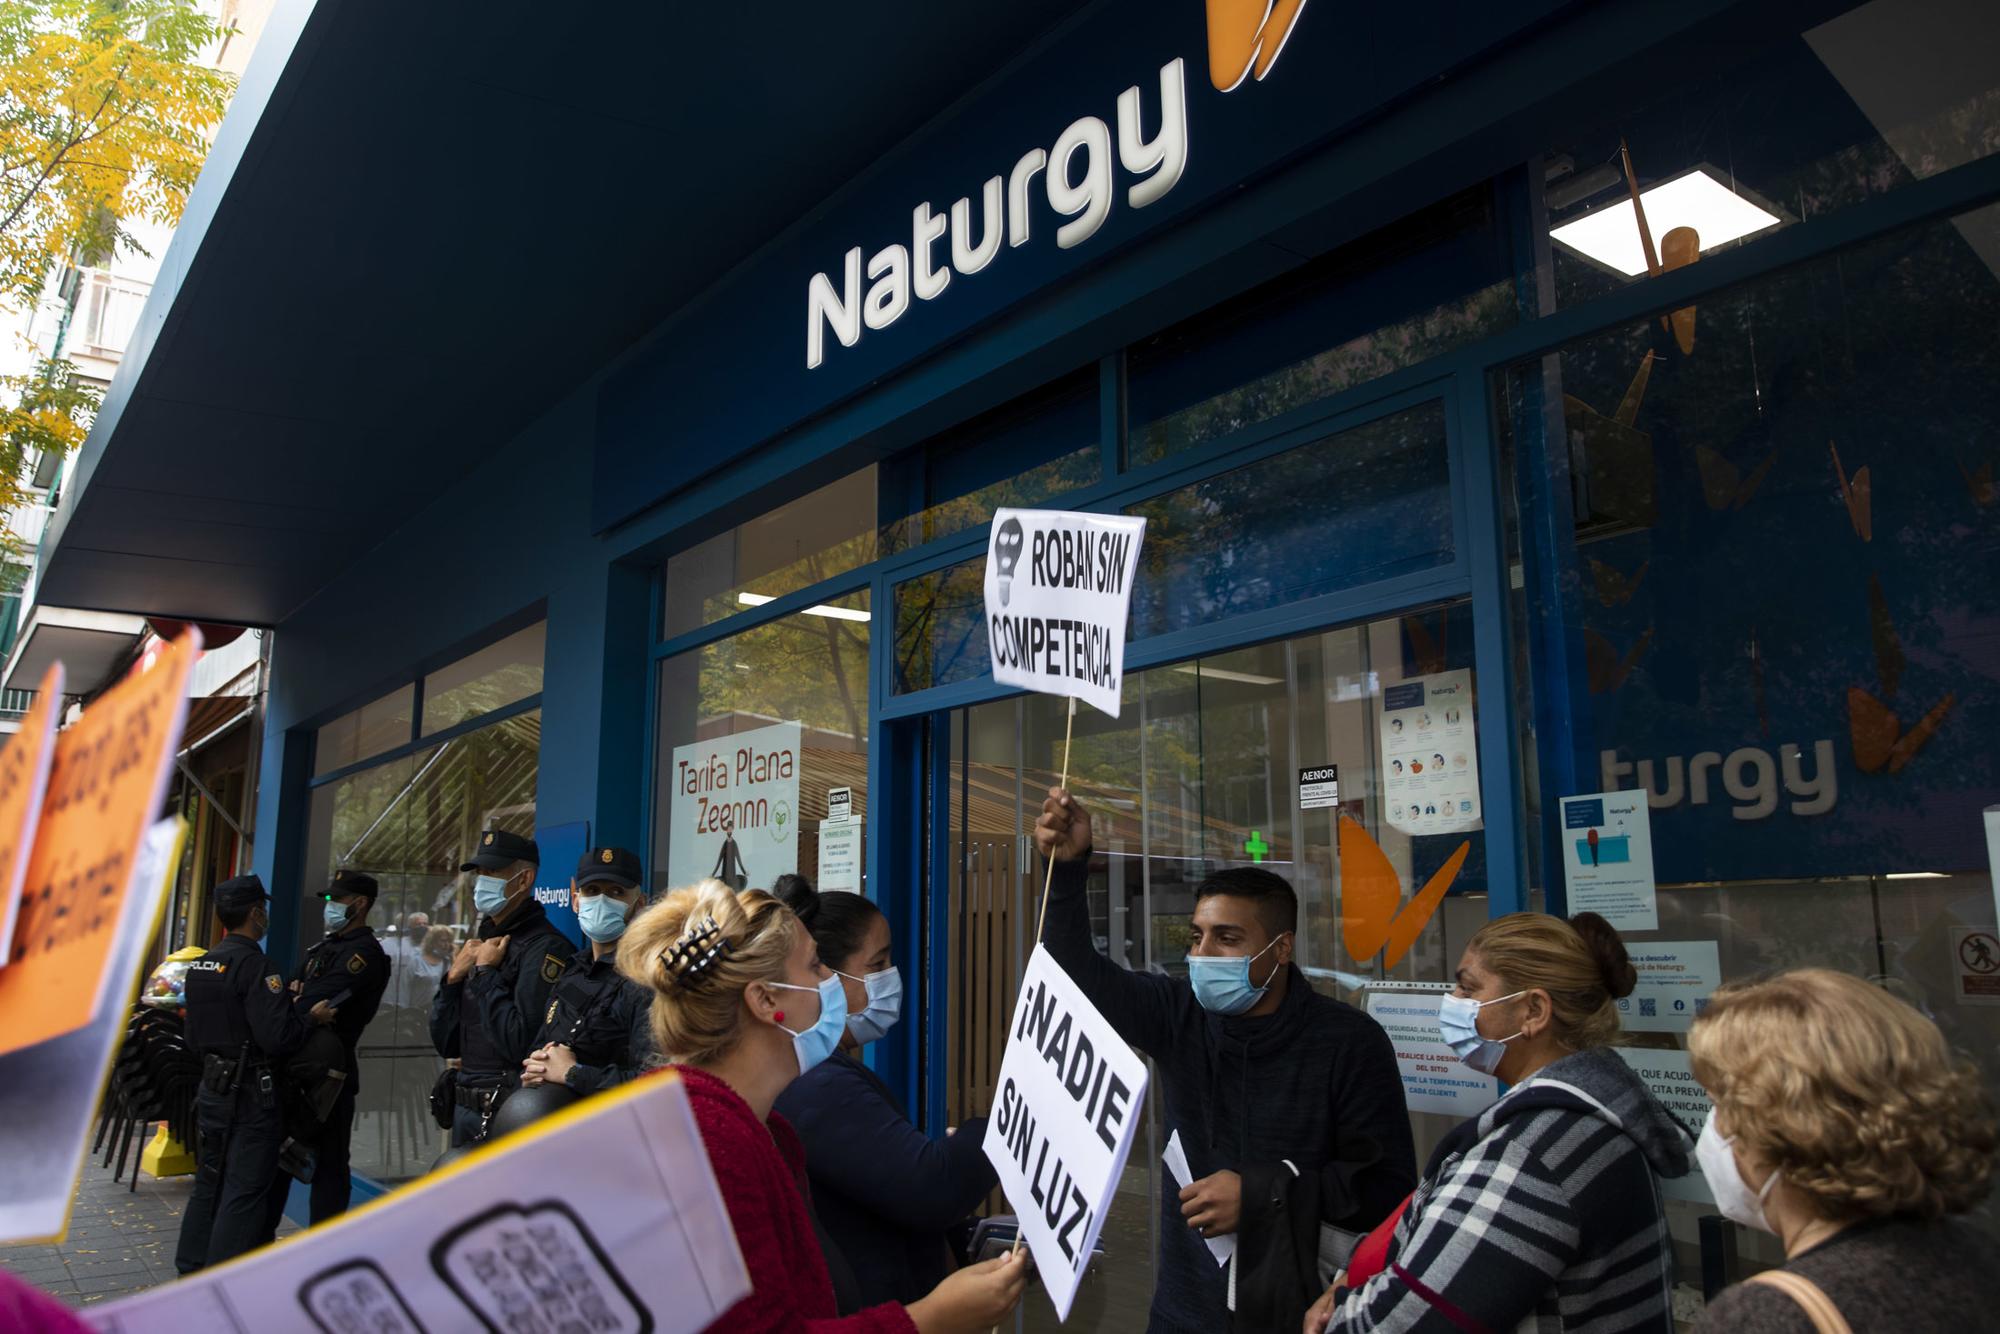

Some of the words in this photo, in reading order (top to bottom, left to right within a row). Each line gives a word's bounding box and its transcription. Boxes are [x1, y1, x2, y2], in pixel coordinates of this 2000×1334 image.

[807, 57, 1188, 370] Naturgy
[1031, 529, 1094, 591] ROBAN
[1097, 531, 1131, 594] SIN
[992, 614, 1116, 691] COMPETENCIA.
[679, 754, 728, 796] Tarifa
[736, 747, 793, 786] Plana
[1302, 769, 1334, 781] AENOR
[697, 797, 767, 834] Zeennn
[534, 886, 570, 908] Naturgy
[1016, 980, 1130, 1153] ¡NADIE
[1397, 1052, 1424, 1060] REALICE
[1416, 1064, 1428, 1072] DEL
[1430, 1065, 1448, 1073] SITIO
[1641, 1069, 1661, 1080] QUE
[1409, 1087, 1427, 1095] CADA
[1428, 1089, 1457, 1097] CLIENTE
[1429, 1078, 1480, 1088] TEMPERATURA
[1651, 1084, 1673, 1095] CITA
[997, 1077, 1036, 1176] SIN
[1031, 1136, 1094, 1273] LUZ!
